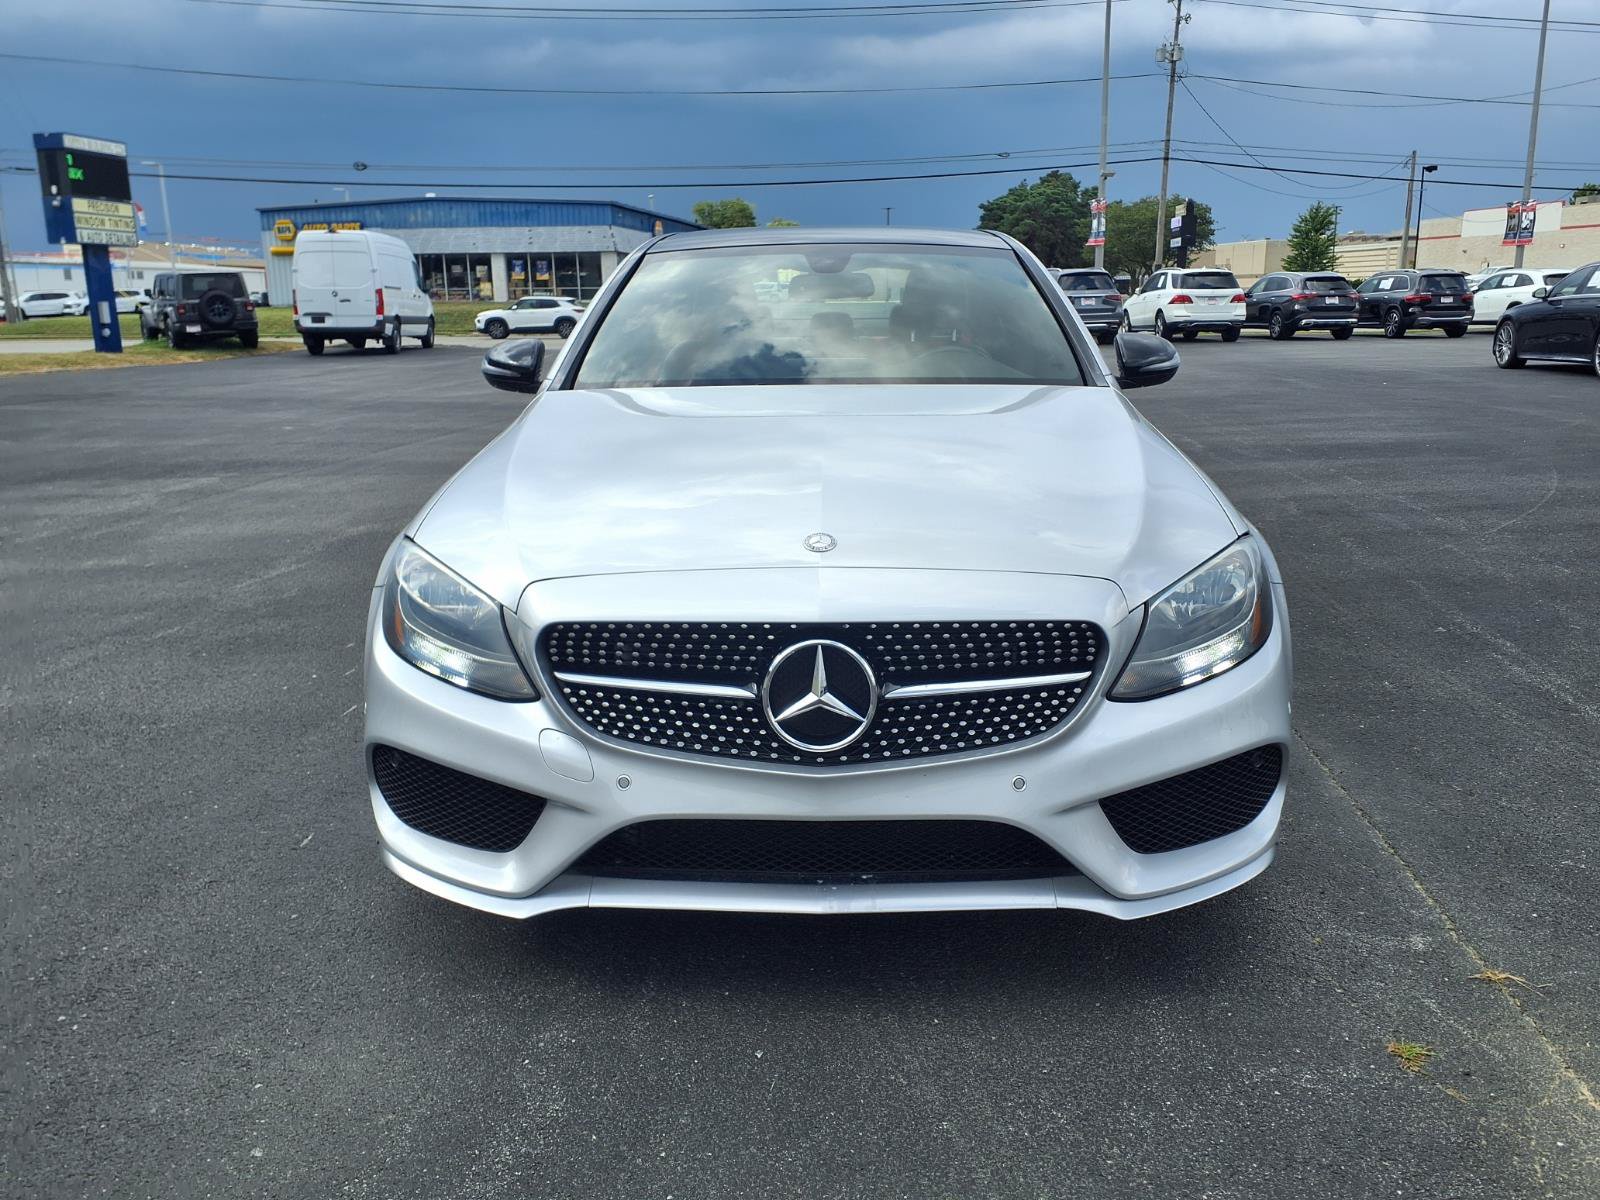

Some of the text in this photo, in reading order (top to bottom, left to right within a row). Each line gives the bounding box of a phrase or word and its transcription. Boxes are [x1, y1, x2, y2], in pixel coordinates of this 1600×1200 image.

[76, 215, 135, 230] WINDOW TINTING
[87, 232, 103, 243] AUTO
